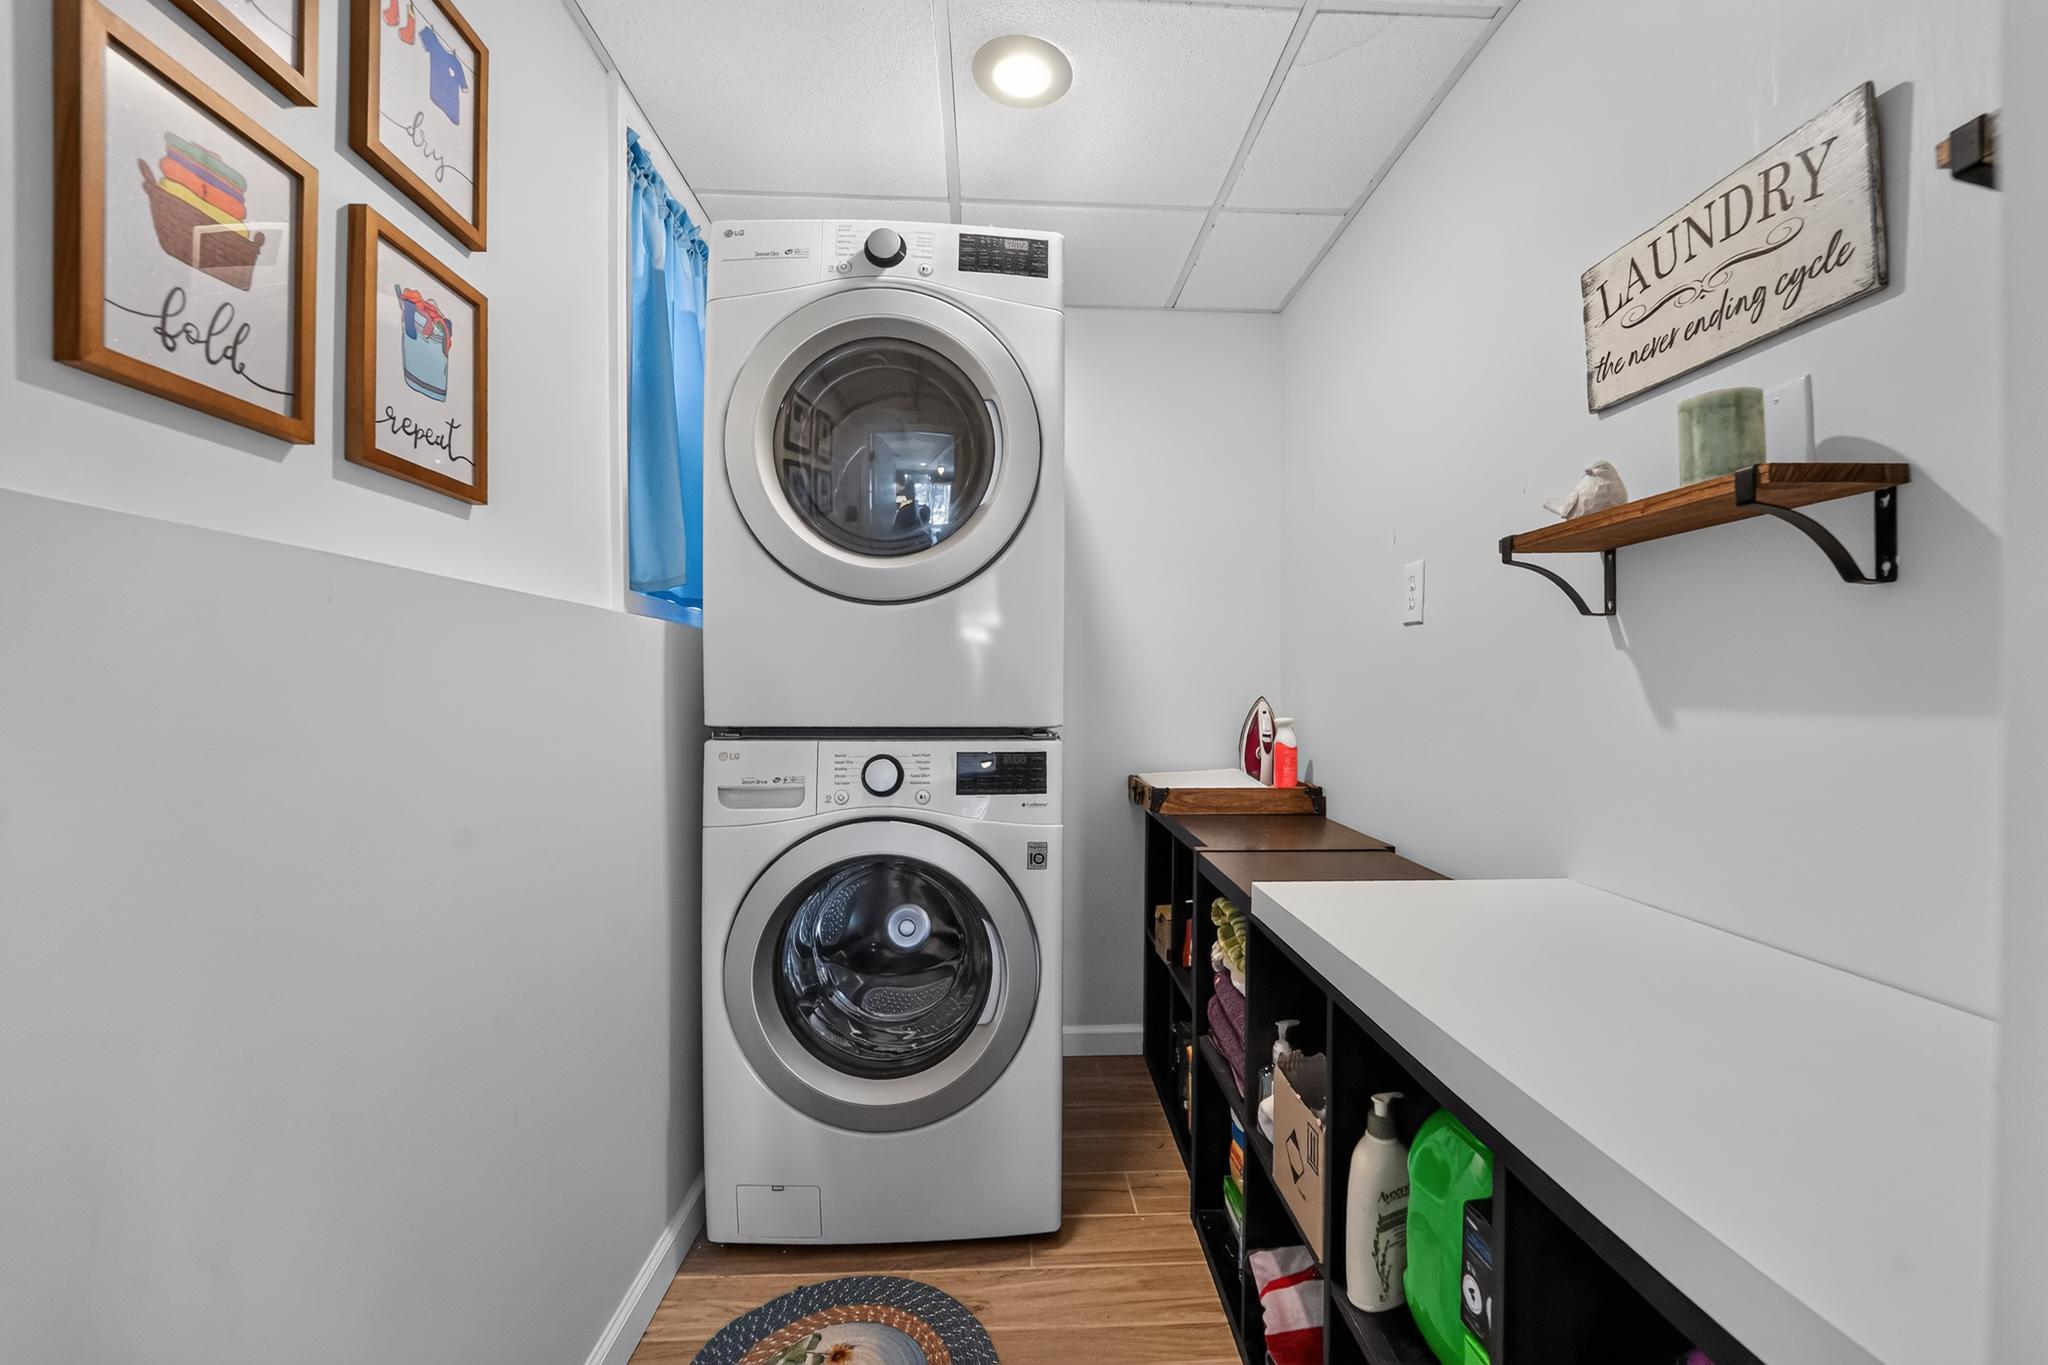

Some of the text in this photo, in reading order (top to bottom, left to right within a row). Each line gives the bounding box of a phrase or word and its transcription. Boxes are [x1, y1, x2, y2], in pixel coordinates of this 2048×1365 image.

[405, 111, 447, 182] dry
[1595, 136, 1838, 325] LAUNDRY
[153, 287, 247, 375] fold
[1594, 229, 1856, 384] the never ending cycle
[384, 406, 463, 462] repeat
